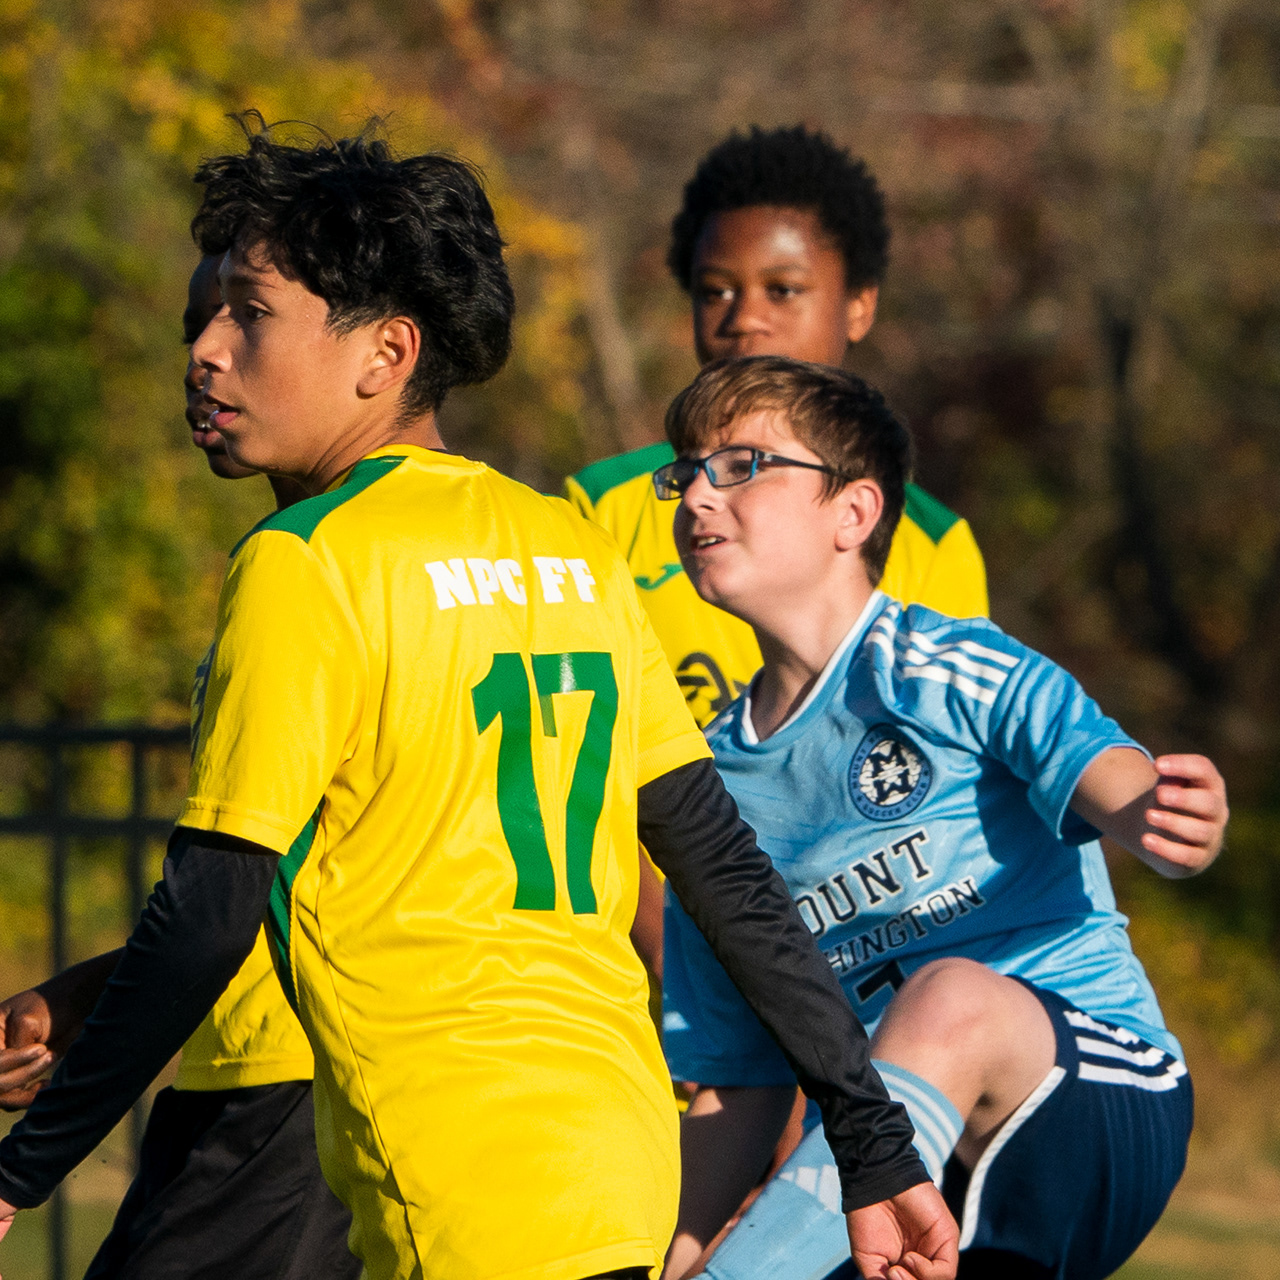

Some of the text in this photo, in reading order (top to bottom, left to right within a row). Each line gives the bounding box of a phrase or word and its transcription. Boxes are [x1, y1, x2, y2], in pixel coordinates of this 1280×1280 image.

[471, 651, 619, 915] 17
[795, 828, 931, 939] OUNT
[824, 876, 987, 974] HINGTON
